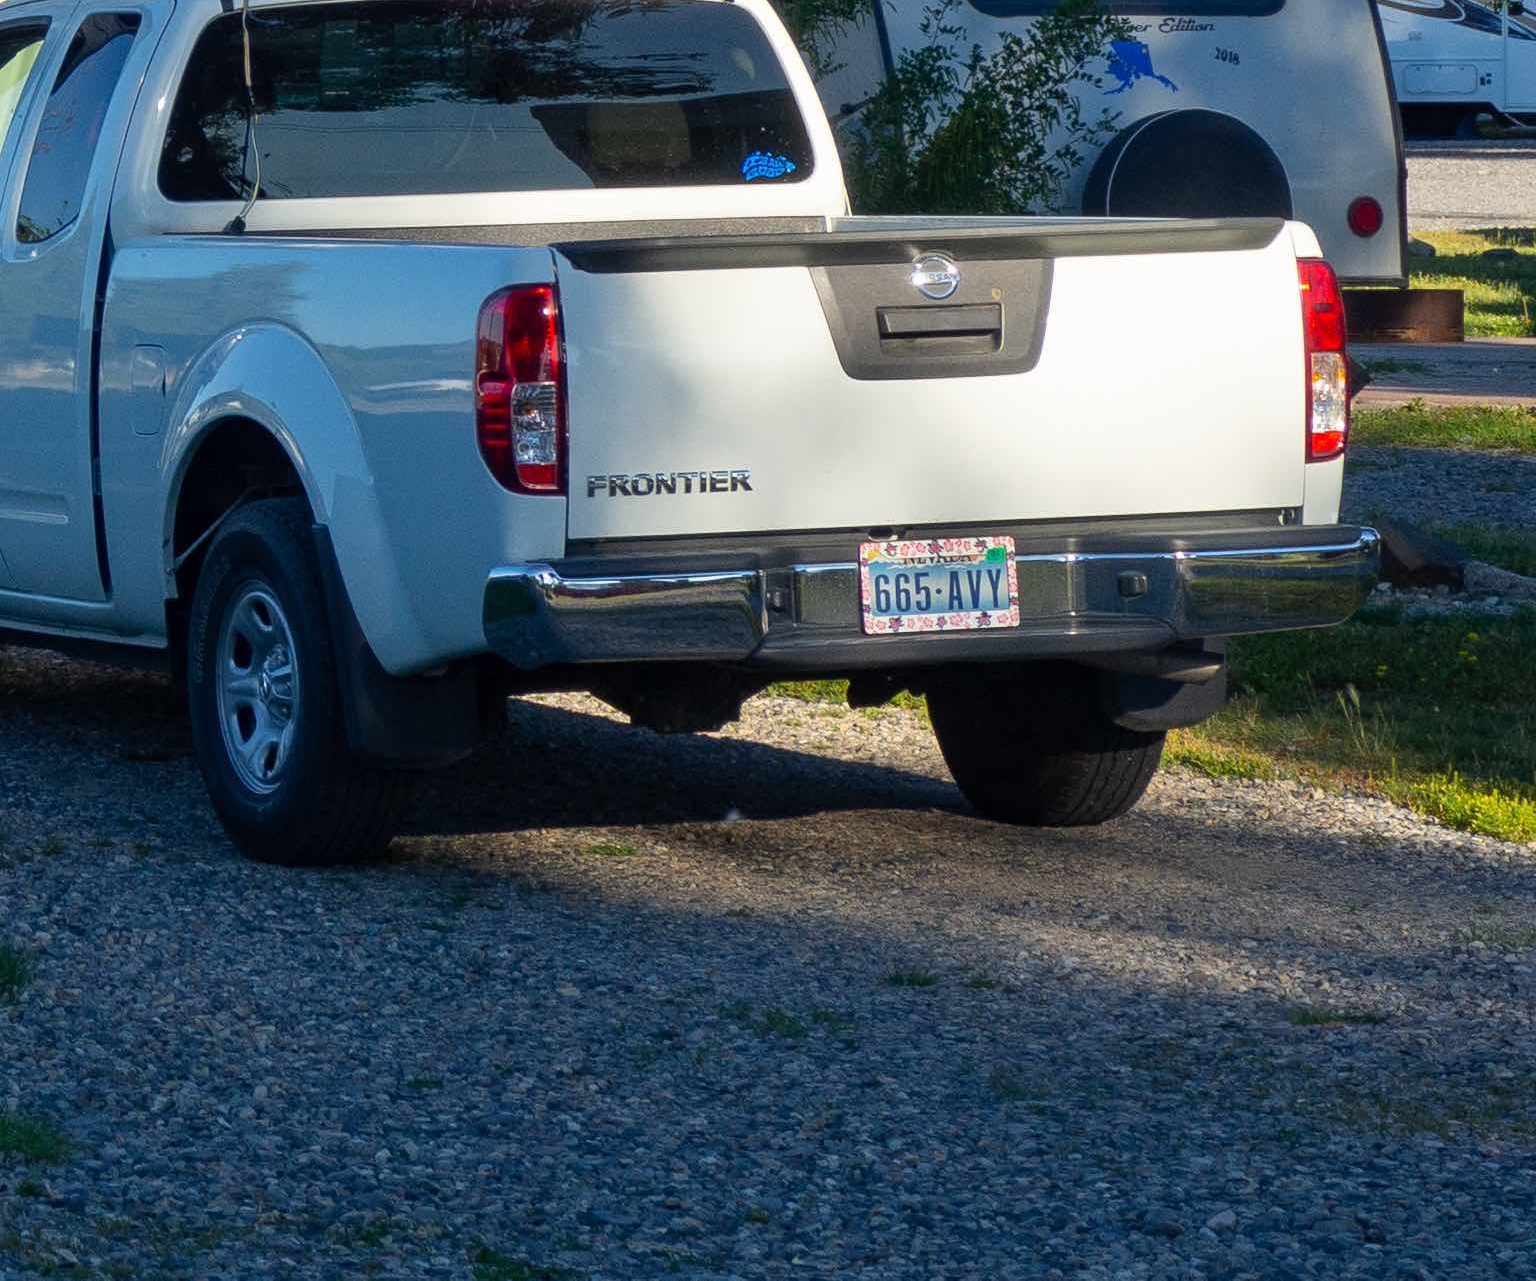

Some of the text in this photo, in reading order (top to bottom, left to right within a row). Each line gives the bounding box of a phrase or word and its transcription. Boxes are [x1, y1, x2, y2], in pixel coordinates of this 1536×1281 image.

[1158, 17, 1216, 34] Edition
[1214, 46, 1241, 65] 2018
[586, 469, 754, 498] FRONTIER
